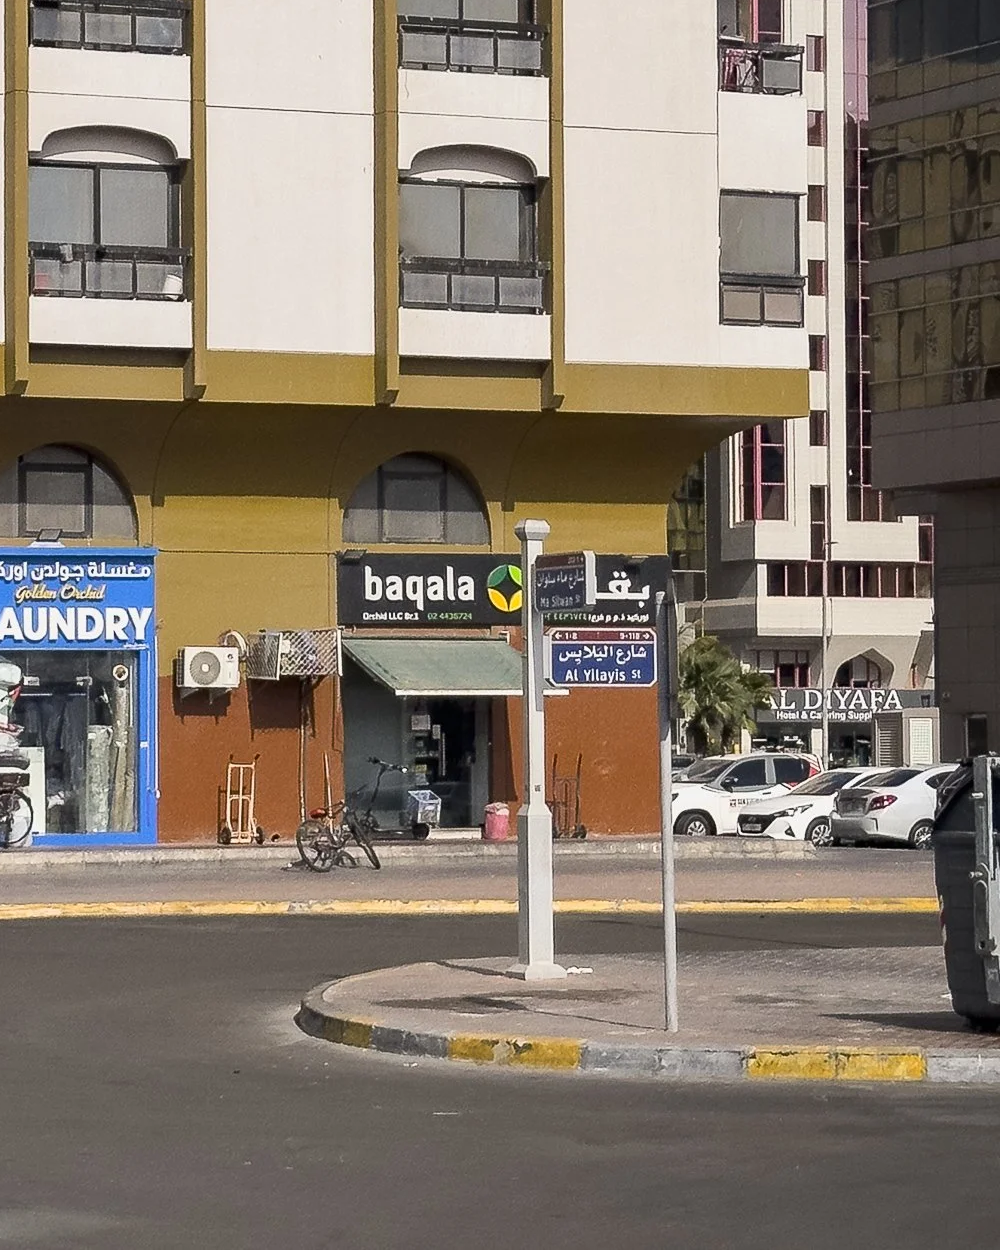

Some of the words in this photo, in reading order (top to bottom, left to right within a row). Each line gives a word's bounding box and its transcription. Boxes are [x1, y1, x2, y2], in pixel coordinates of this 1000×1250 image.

[31, 561, 84, 582] جولدن
[88, 561, 151, 578] مغسلة
[15, 584, 57, 604] Golden
[60, 583, 107, 599] Orchid
[364, 565, 475, 611] baqala
[362, 611, 388, 621] Orchid
[388, 612, 403, 621] LLC
[427, 612, 437, 620] 02
[616, 644, 647, 665] شارع
[565, 668, 579, 682] Al
[631, 669, 641, 679] St
[776, 710, 800, 720] Hotel
[800, 710, 808, 720] &
[810, 710, 846, 721] Caring
[847, 709, 881, 722] Suppl
